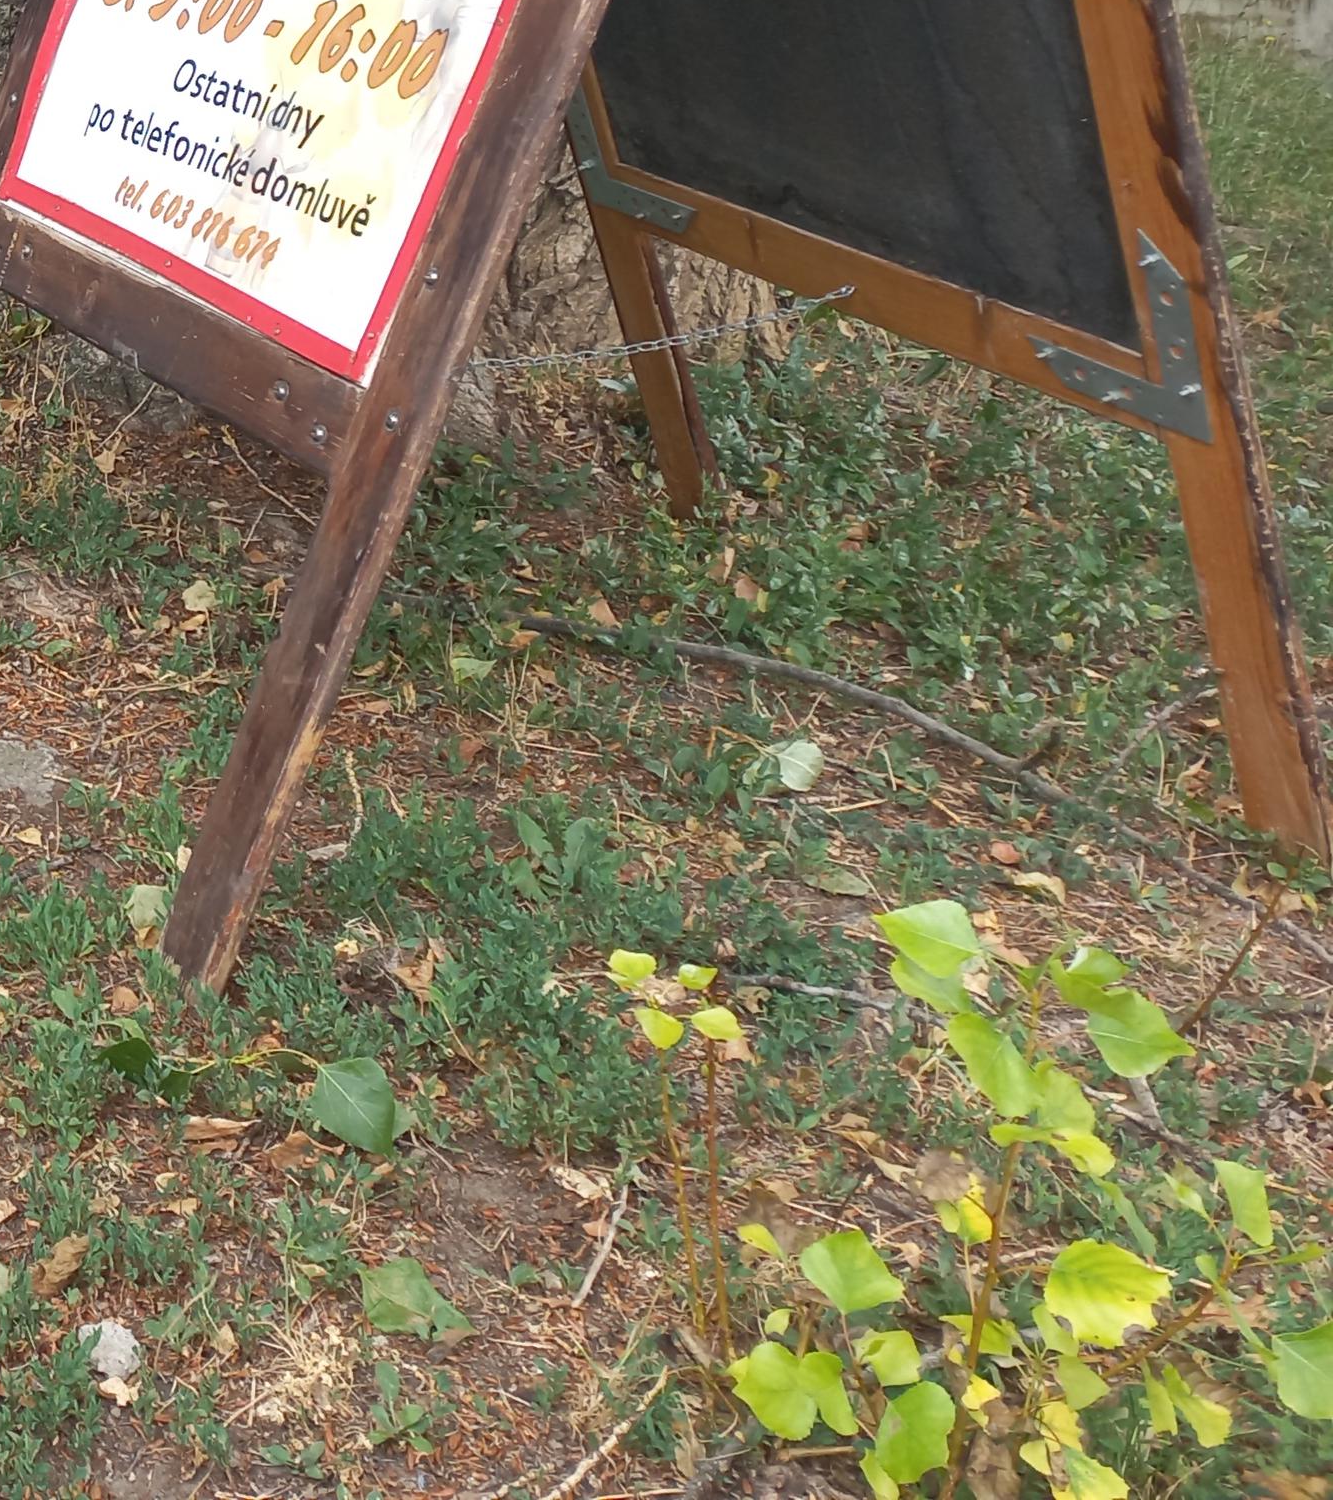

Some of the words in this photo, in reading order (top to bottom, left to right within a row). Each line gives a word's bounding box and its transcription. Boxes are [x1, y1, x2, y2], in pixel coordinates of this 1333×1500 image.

[263, 19, 285, 38] -
[290, 0, 450, 100] 16:00
[173, 58, 278, 122] Ostatní
[271, 91, 325, 149] dny
[83, 102, 115, 137] po
[120, 108, 258, 187] telefonické
[251, 157, 377, 237] domluvě
[114, 175, 150, 213] tel.
[149, 188, 195, 230] 603
